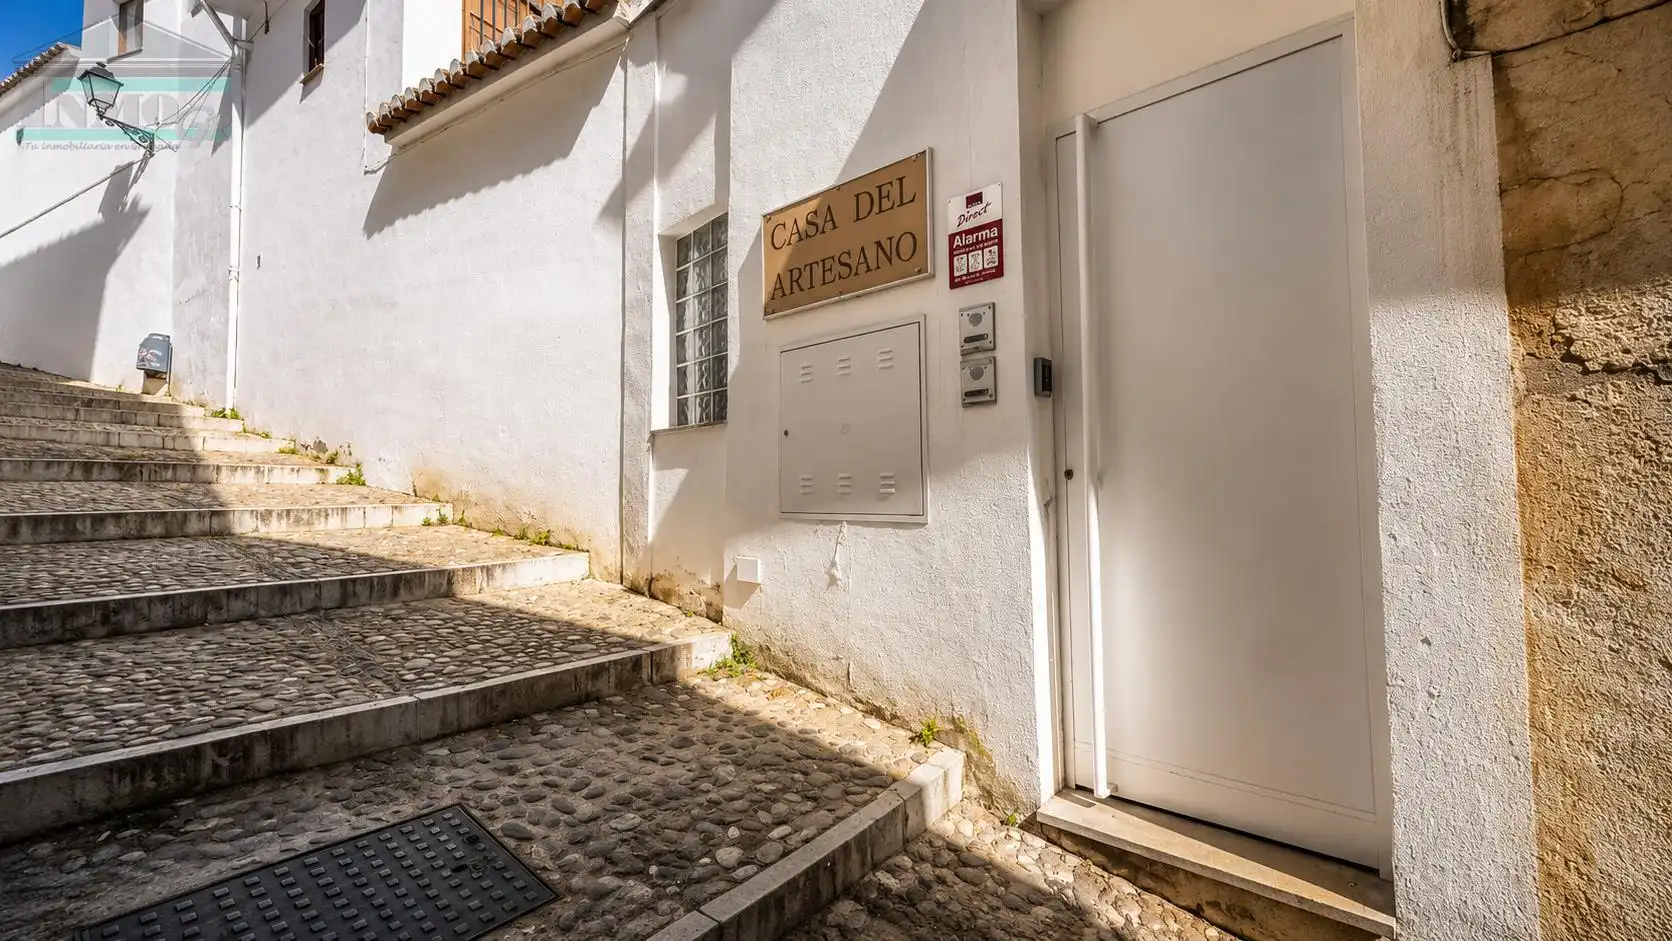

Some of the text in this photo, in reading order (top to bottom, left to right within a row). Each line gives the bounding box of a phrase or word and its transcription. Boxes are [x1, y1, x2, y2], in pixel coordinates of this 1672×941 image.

[771, 176, 916, 250] CASA DEL
[957, 201, 992, 227] Direct
[953, 227, 998, 249] Alarma
[770, 231, 918, 300] ARTESANO
